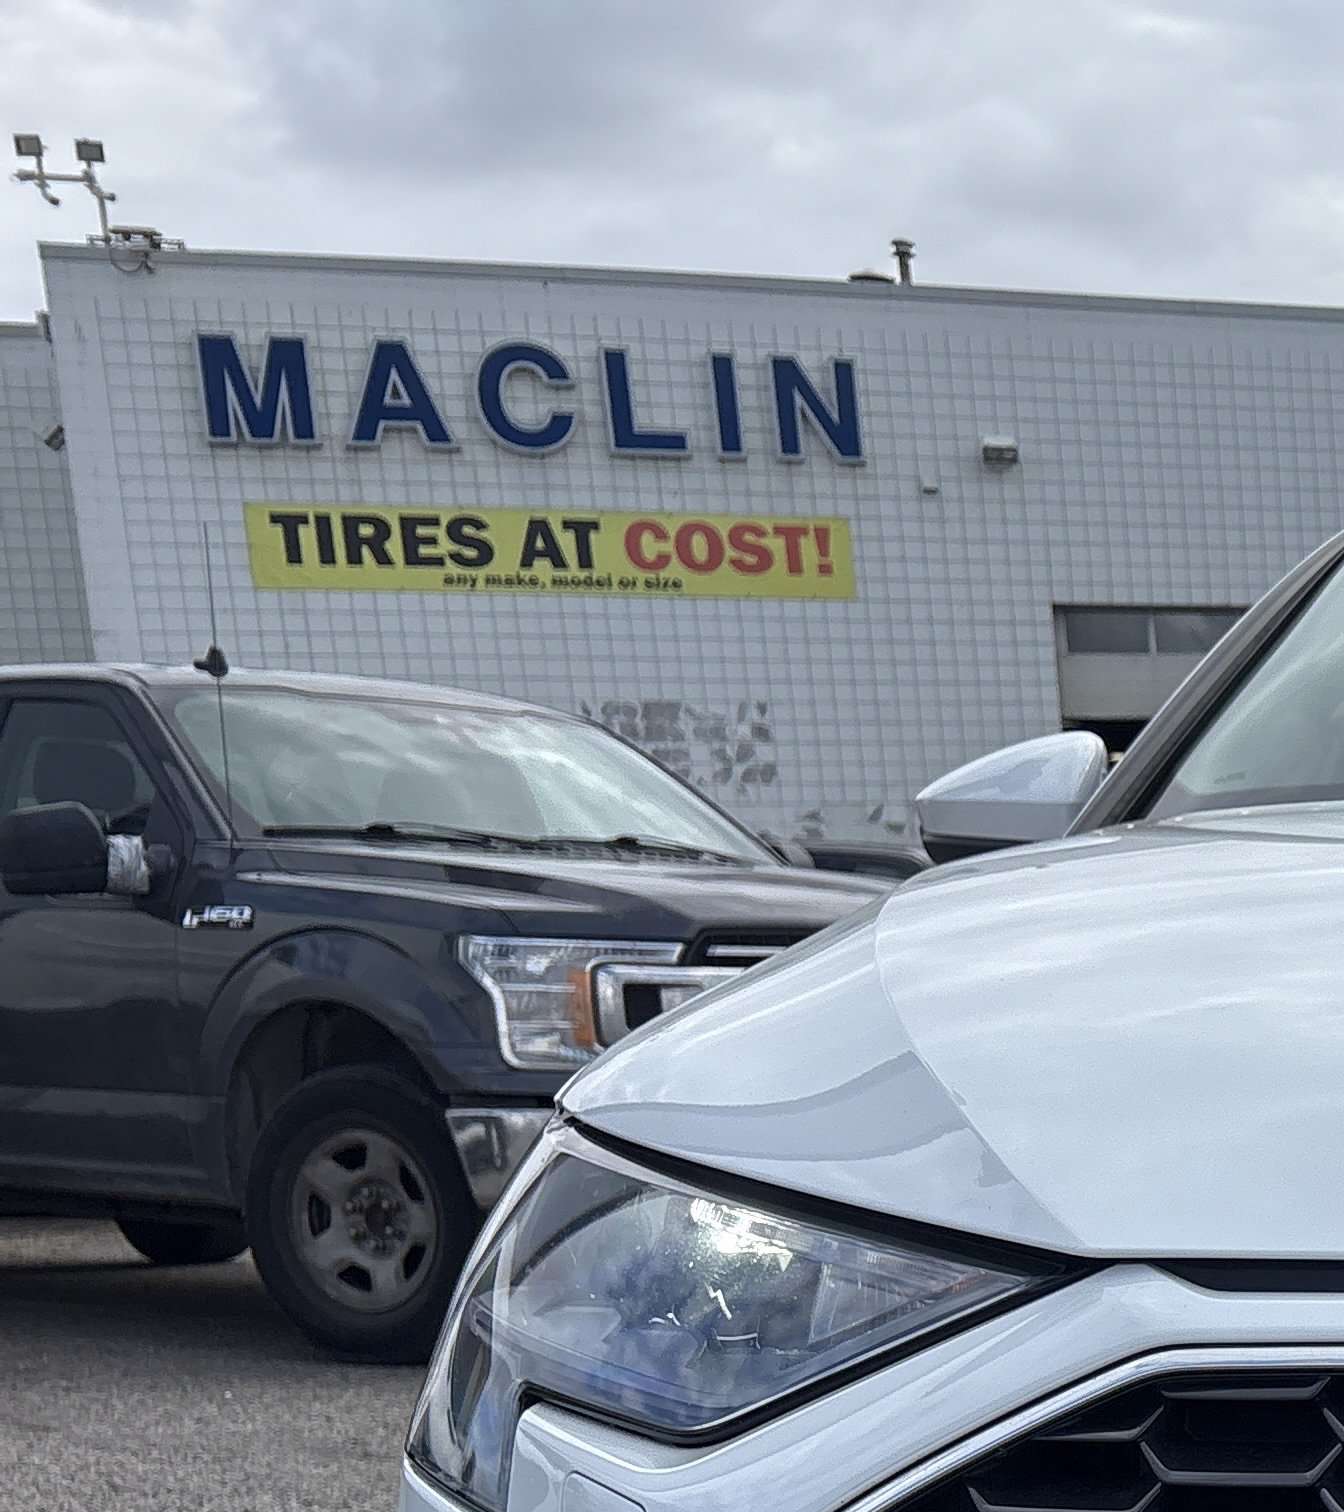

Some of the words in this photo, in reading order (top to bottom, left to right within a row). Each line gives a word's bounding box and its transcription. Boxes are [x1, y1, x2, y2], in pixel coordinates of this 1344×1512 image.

[196, 332, 867, 465] MACLIN
[268, 510, 495, 568] TIRES
[519, 515, 599, 569] AT
[623, 518, 834, 576] COST!
[443, 573, 478, 591] any
[485, 572, 546, 591] make,
[552, 573, 613, 589] model
[618, 577, 640, 590] or
[644, 574, 683, 590] size
